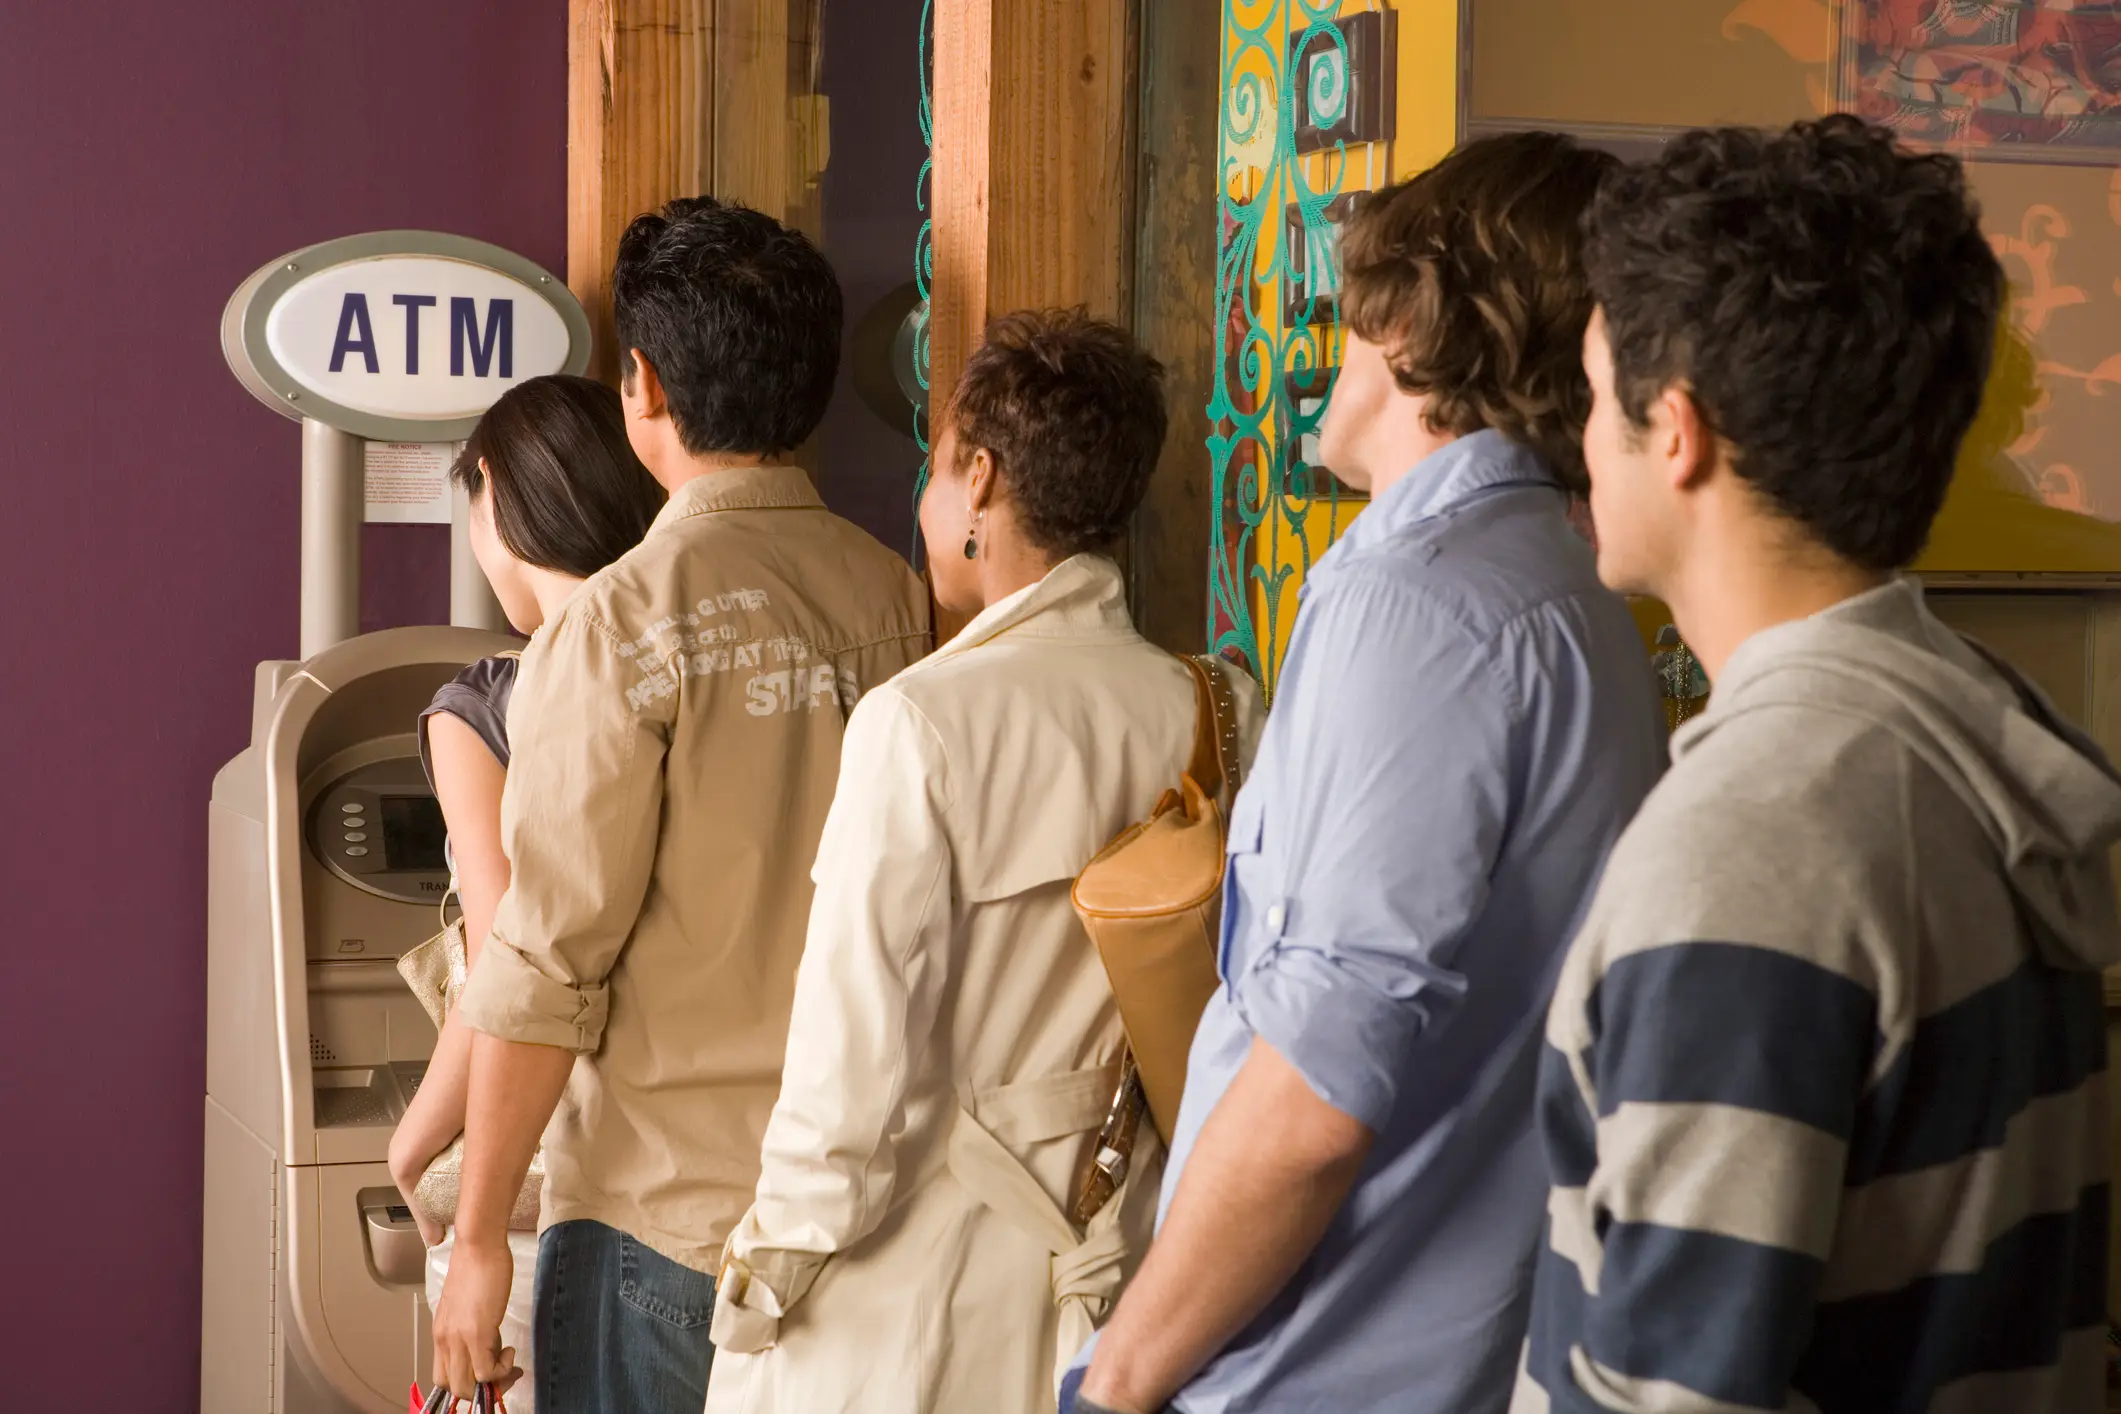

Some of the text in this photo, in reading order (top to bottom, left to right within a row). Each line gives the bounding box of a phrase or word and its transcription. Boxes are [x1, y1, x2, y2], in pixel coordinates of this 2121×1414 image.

[328, 293, 513, 378] ATM
[733, 641, 762, 669] AT
[745, 663, 858, 717] STARS
[419, 882, 450, 891] TRAN
